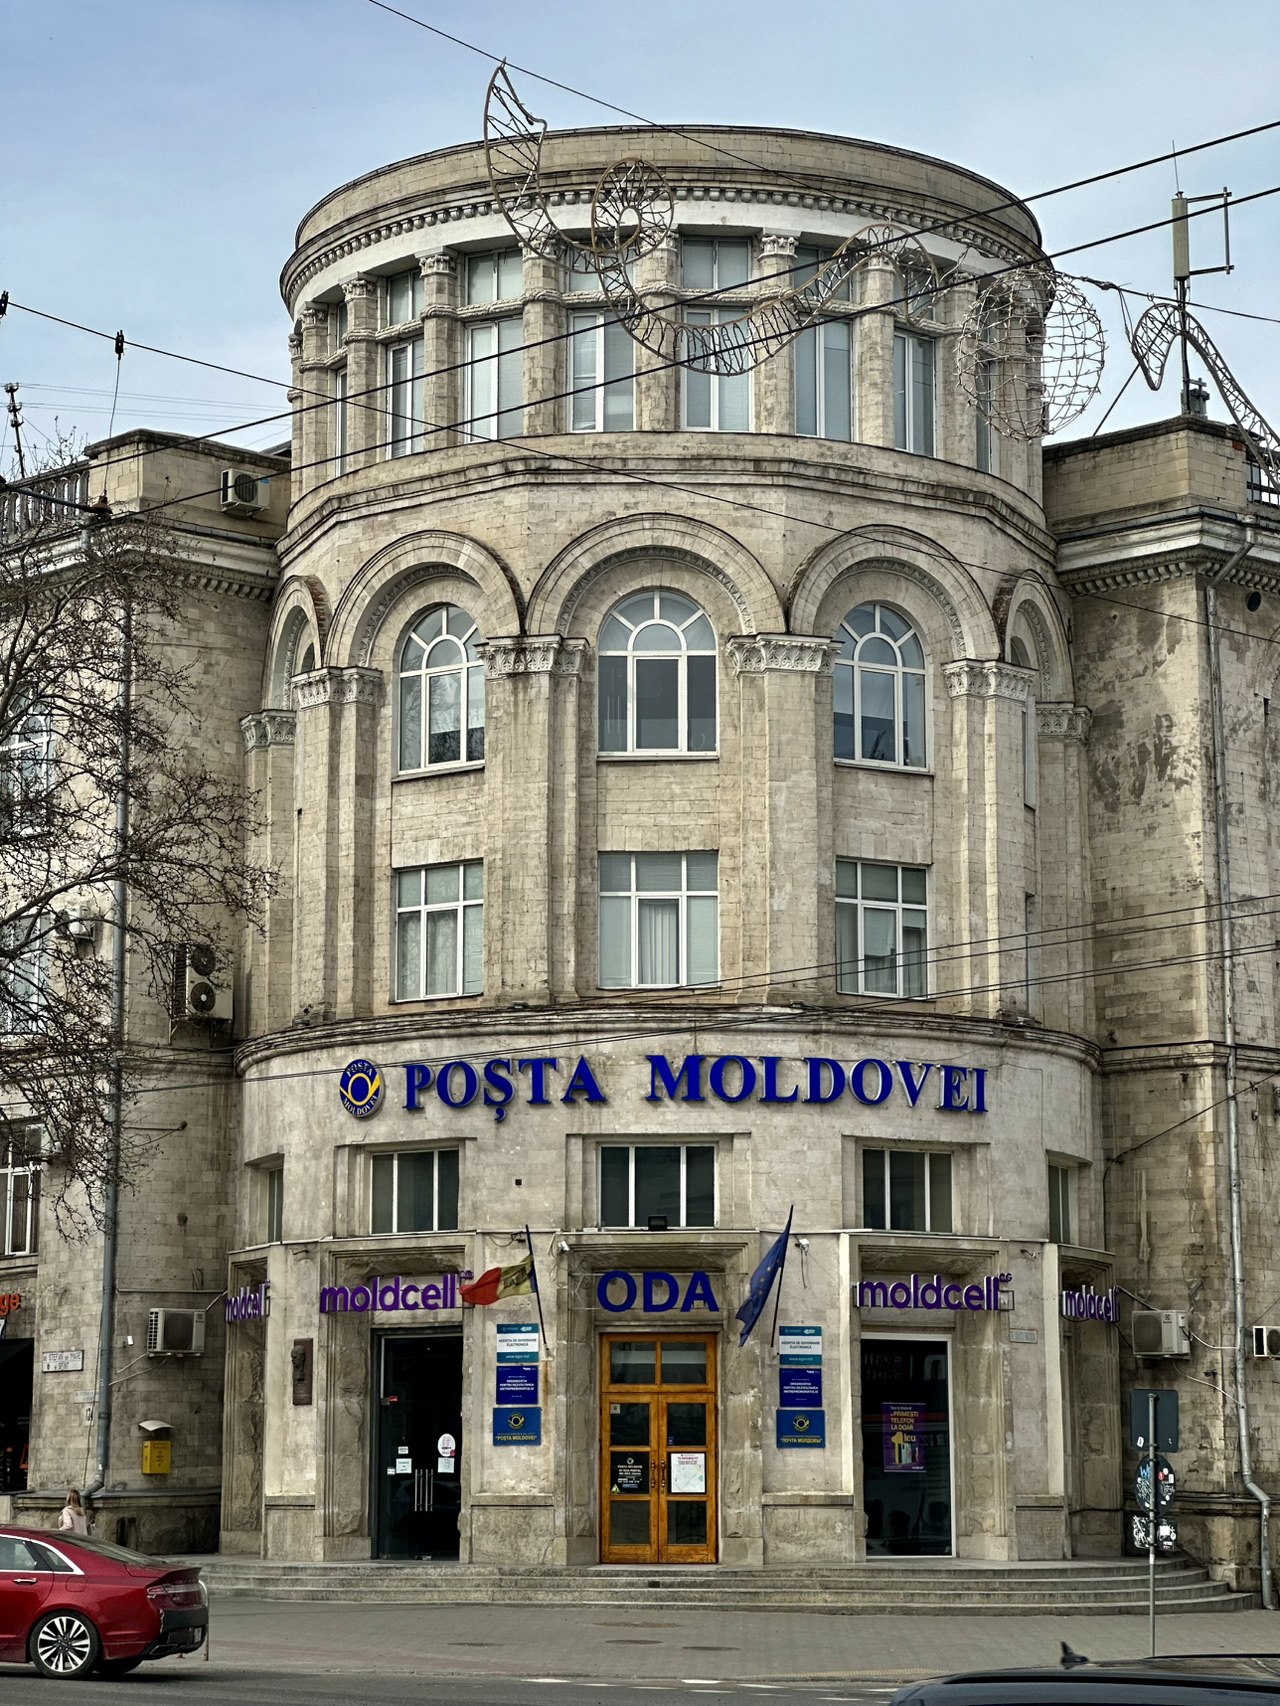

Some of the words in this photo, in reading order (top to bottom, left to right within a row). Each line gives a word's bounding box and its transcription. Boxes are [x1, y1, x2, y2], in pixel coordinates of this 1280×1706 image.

[402, 1055, 608, 1122] POȘTA
[645, 1054, 989, 1113] MOLDOVEI
[225, 1283, 264, 1323] moldcell
[320, 1273, 458, 1314] moldcell
[597, 1270, 719, 1313] ODA
[856, 1273, 1000, 1311] moldcell
[1061, 1284, 1119, 1322] moldcell
[903, 1433, 917, 1443] leu
